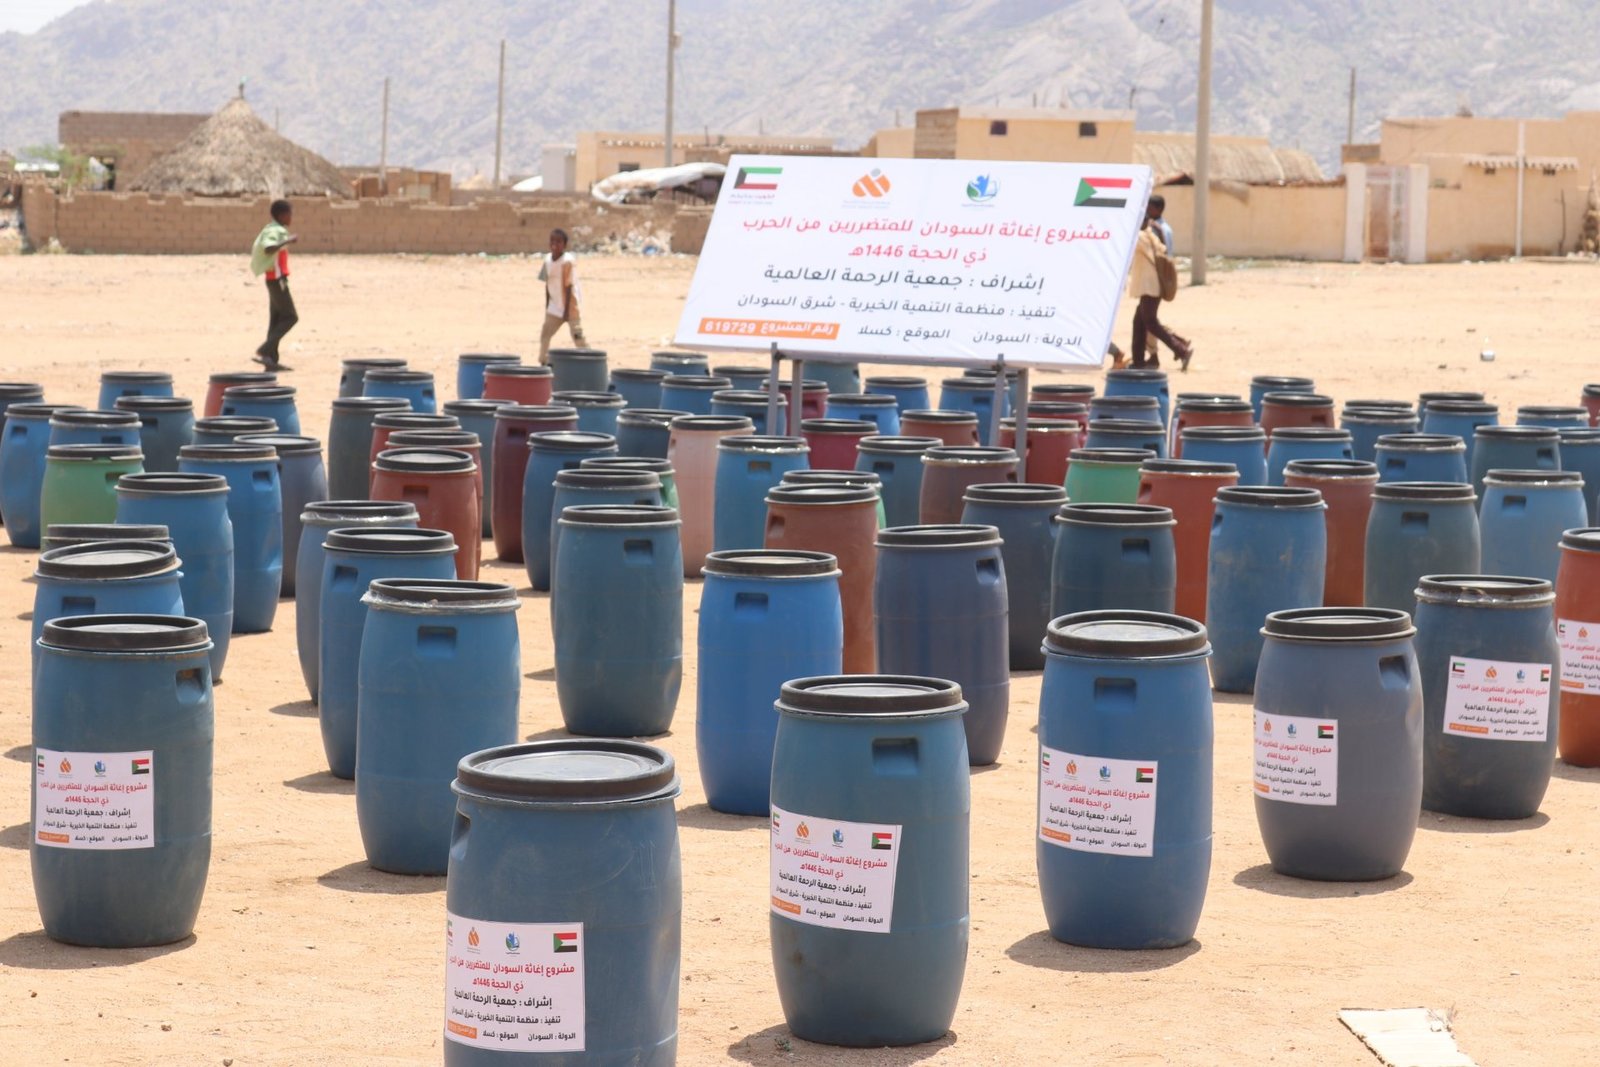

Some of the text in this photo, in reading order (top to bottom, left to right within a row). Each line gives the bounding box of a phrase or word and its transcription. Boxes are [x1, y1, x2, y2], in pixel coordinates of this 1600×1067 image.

[744, 217, 1110, 244] مشروع إغاثة السودان للمتضررين من الحرب
[909, 244, 958, 262] الحجة
[963, 248, 987, 268] ذي
[764, 265, 837, 283] العالمية
[842, 268, 899, 286] الرحمة
[905, 271, 962, 290] جمعية
[981, 273, 1045, 295] إشراف
[738, 294, 797, 307] السودان
[800, 296, 835, 309] شرق
[850, 299, 898, 312] الخيرية
[902, 300, 951, 315] التنمية
[955, 302, 1005, 315] منظمة
[1018, 307, 1056, 320] تنفيذ
[705, 321, 834, 335] رقم المشروع 619729
[858, 326, 892, 336] كسلا
[903, 329, 950, 342] الموقع
[973, 331, 1030, 344] السودان
[1042, 334, 1082, 347] الدولة
[1110, 814, 1131, 824] إشراف
[821, 853, 844, 863] السودان
[846, 857, 861, 868] إغاثة
[863, 859, 887, 869] مشروع
[818, 867, 833, 876] الحجة
[799, 876, 816, 886] الرحمة
[817, 880, 837, 892] جمعية
[843, 885, 866, 896] إشراف
[493, 965, 522, 974] السودان
[525, 964, 543, 976] إغاثة
[546, 963, 574, 977] مشروع
[492, 980, 511, 990] الحجة
[514, 982, 524, 994] ذي
[473, 992, 491, 1005] الرحمة
[493, 996, 517, 1008] جمعية
[524, 996, 552, 1009] إشراف
[496, 1015, 515, 1024] التنمية
[517, 1016, 538, 1024] منظمة
[544, 1016, 560, 1025] تنفيذ
[528, 1033, 553, 1041] السودان
